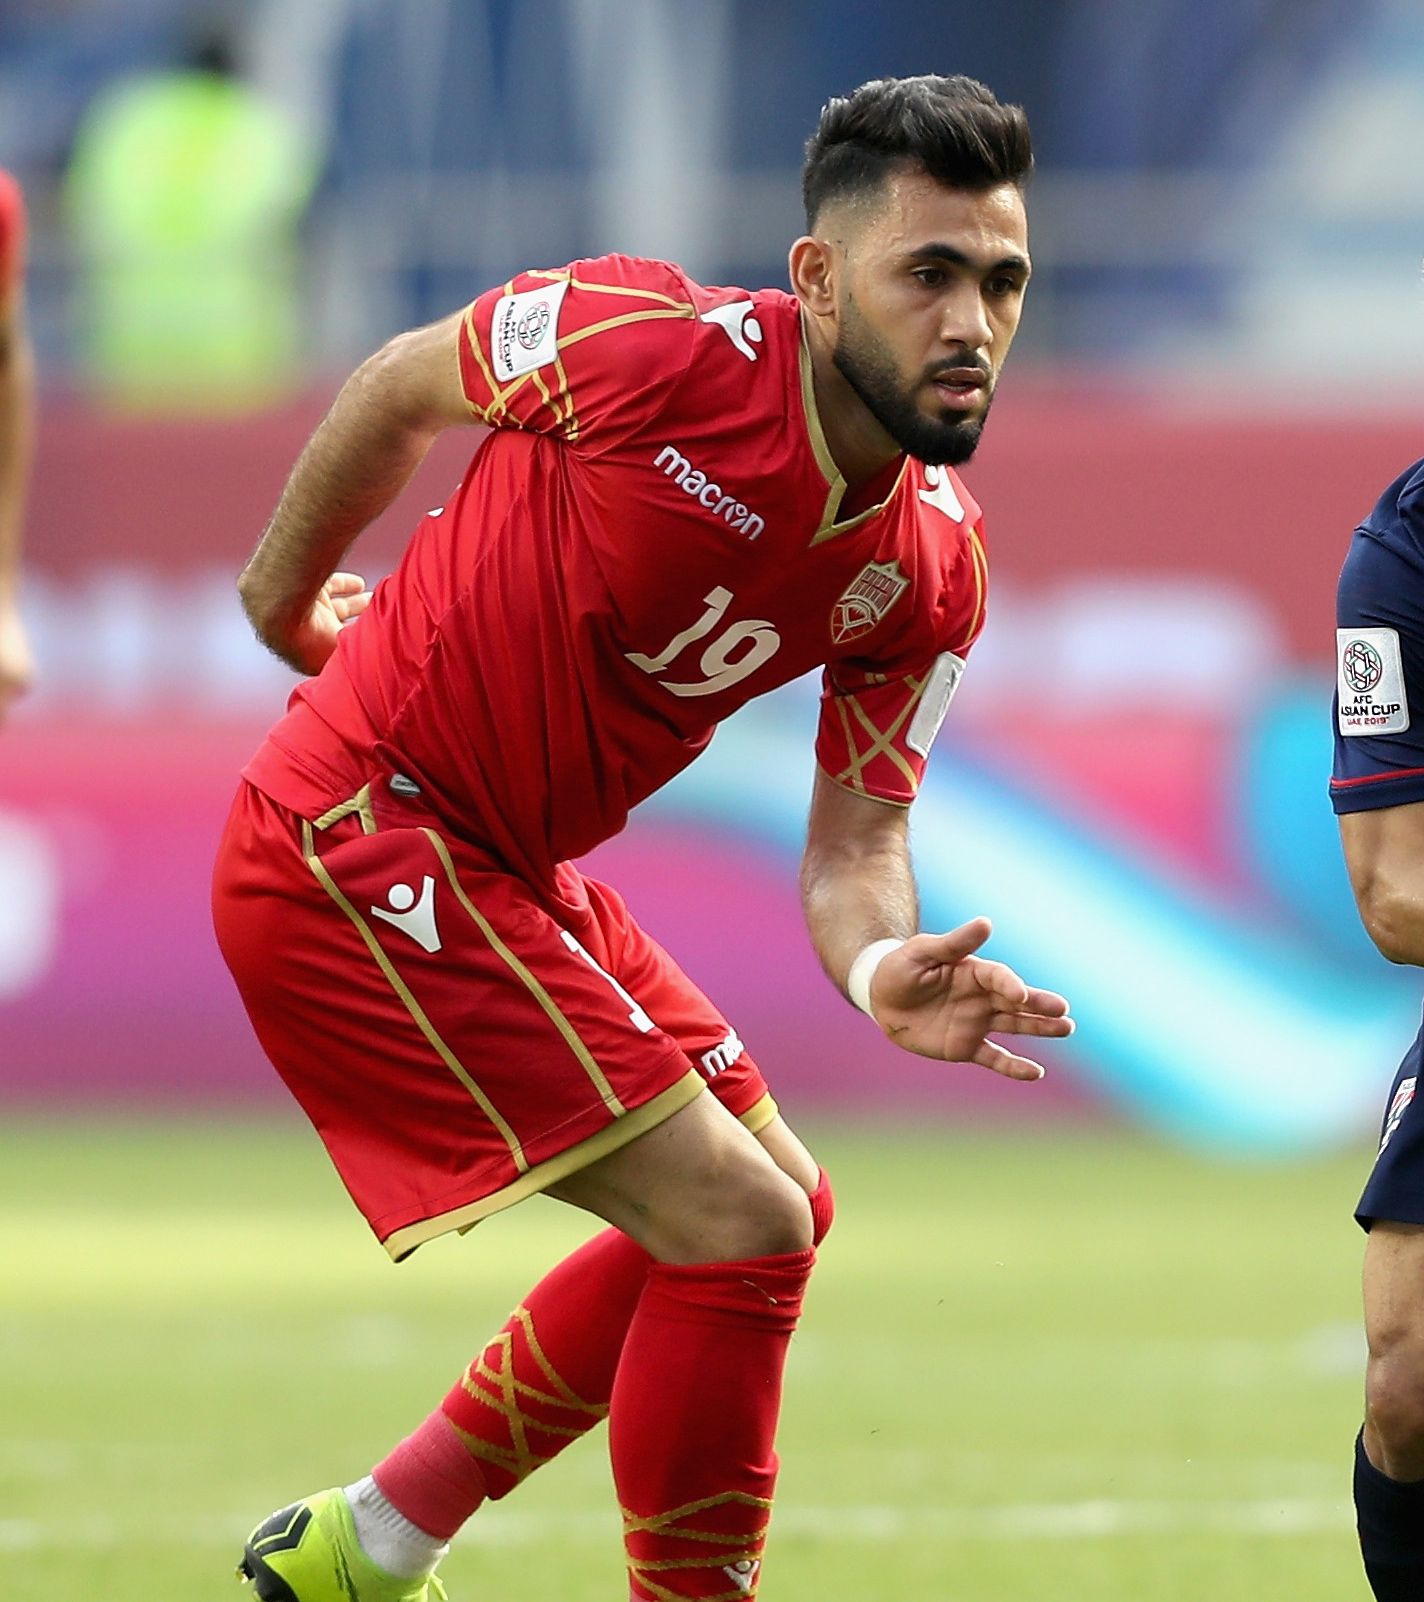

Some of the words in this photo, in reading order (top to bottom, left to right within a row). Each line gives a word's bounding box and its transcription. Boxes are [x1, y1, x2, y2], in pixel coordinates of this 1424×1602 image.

[503, 343, 514, 372] CUP
[653, 445, 765, 540] macron
[623, 585, 781, 697] 19
[1353, 695, 1373, 705] AFC
[1371, 703, 1401, 716] CUP
